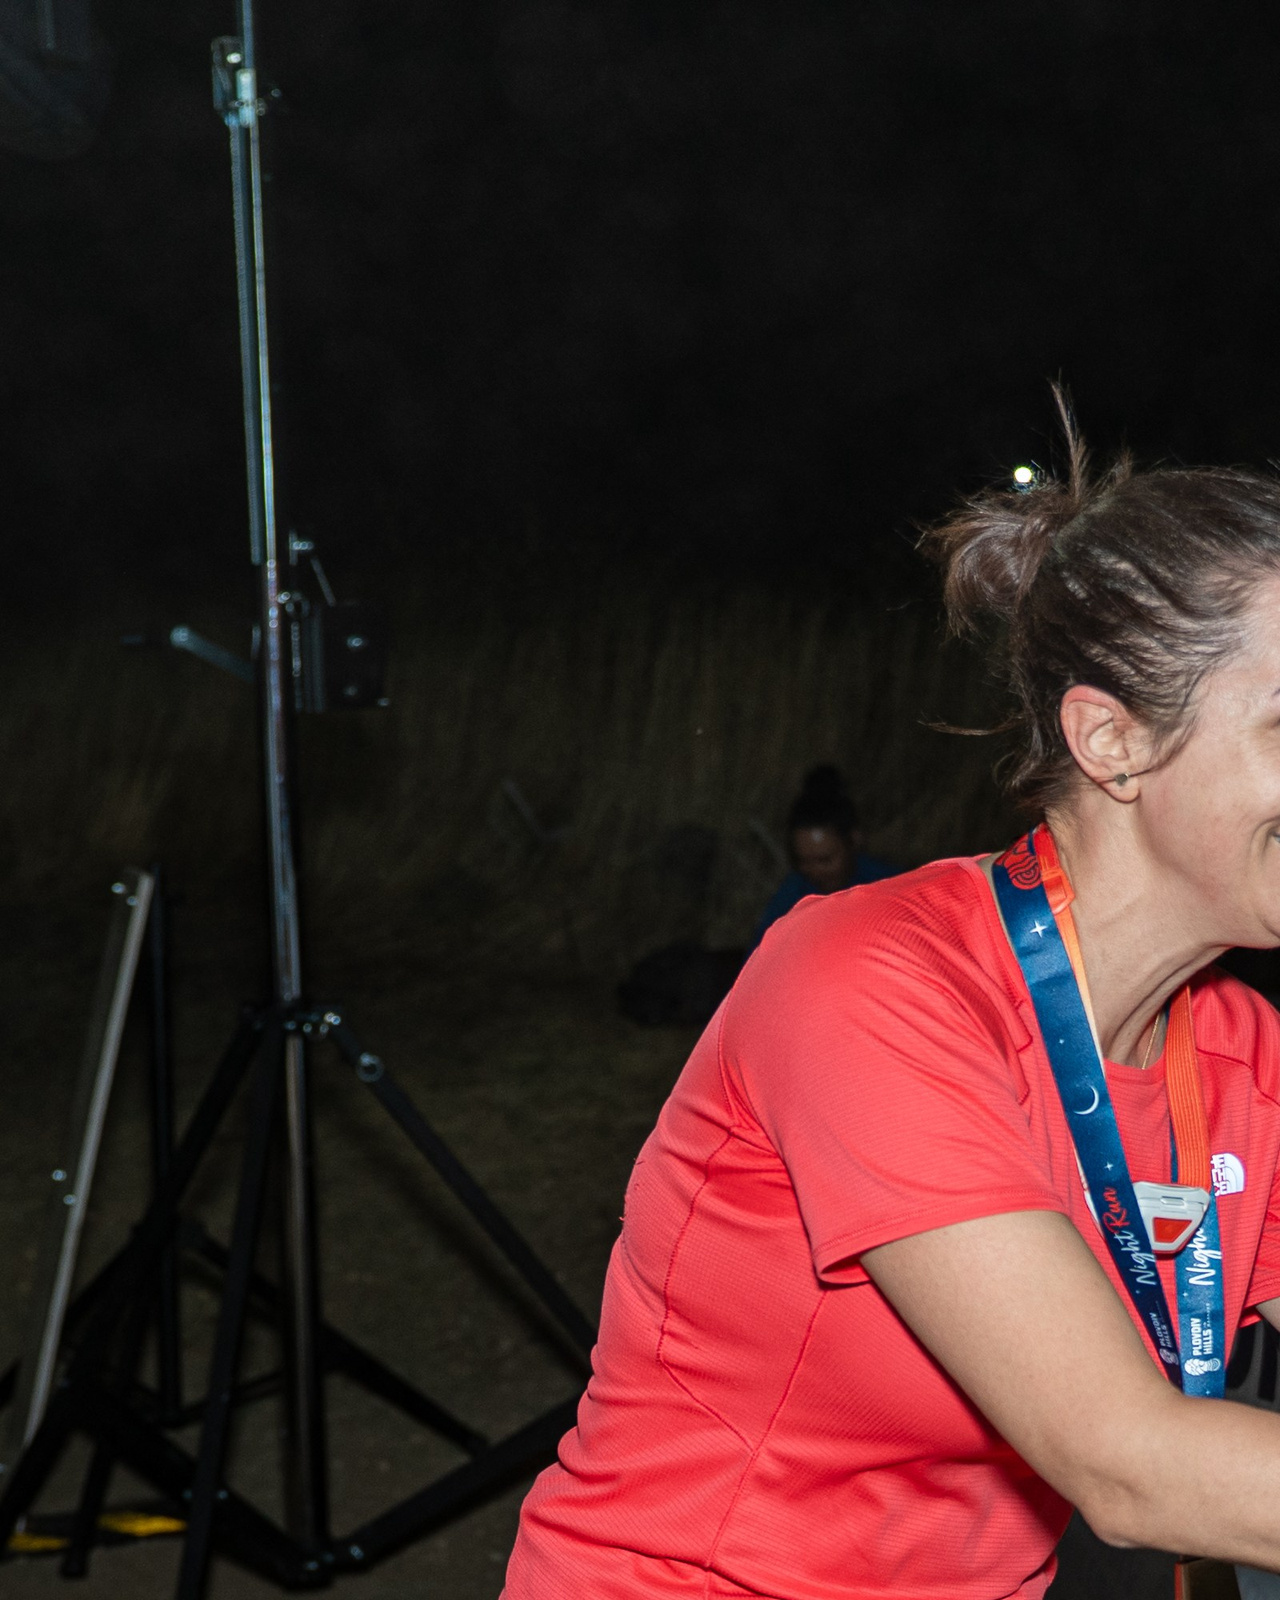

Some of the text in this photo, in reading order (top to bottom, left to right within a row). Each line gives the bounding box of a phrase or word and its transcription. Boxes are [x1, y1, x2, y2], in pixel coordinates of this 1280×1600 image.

[1102, 1186, 1157, 1286] Night Run
[1185, 1228, 1223, 1286] Nigh
[1190, 1317, 1203, 1356] PLOVDIV
[1202, 1328, 1213, 1355] HILLS
